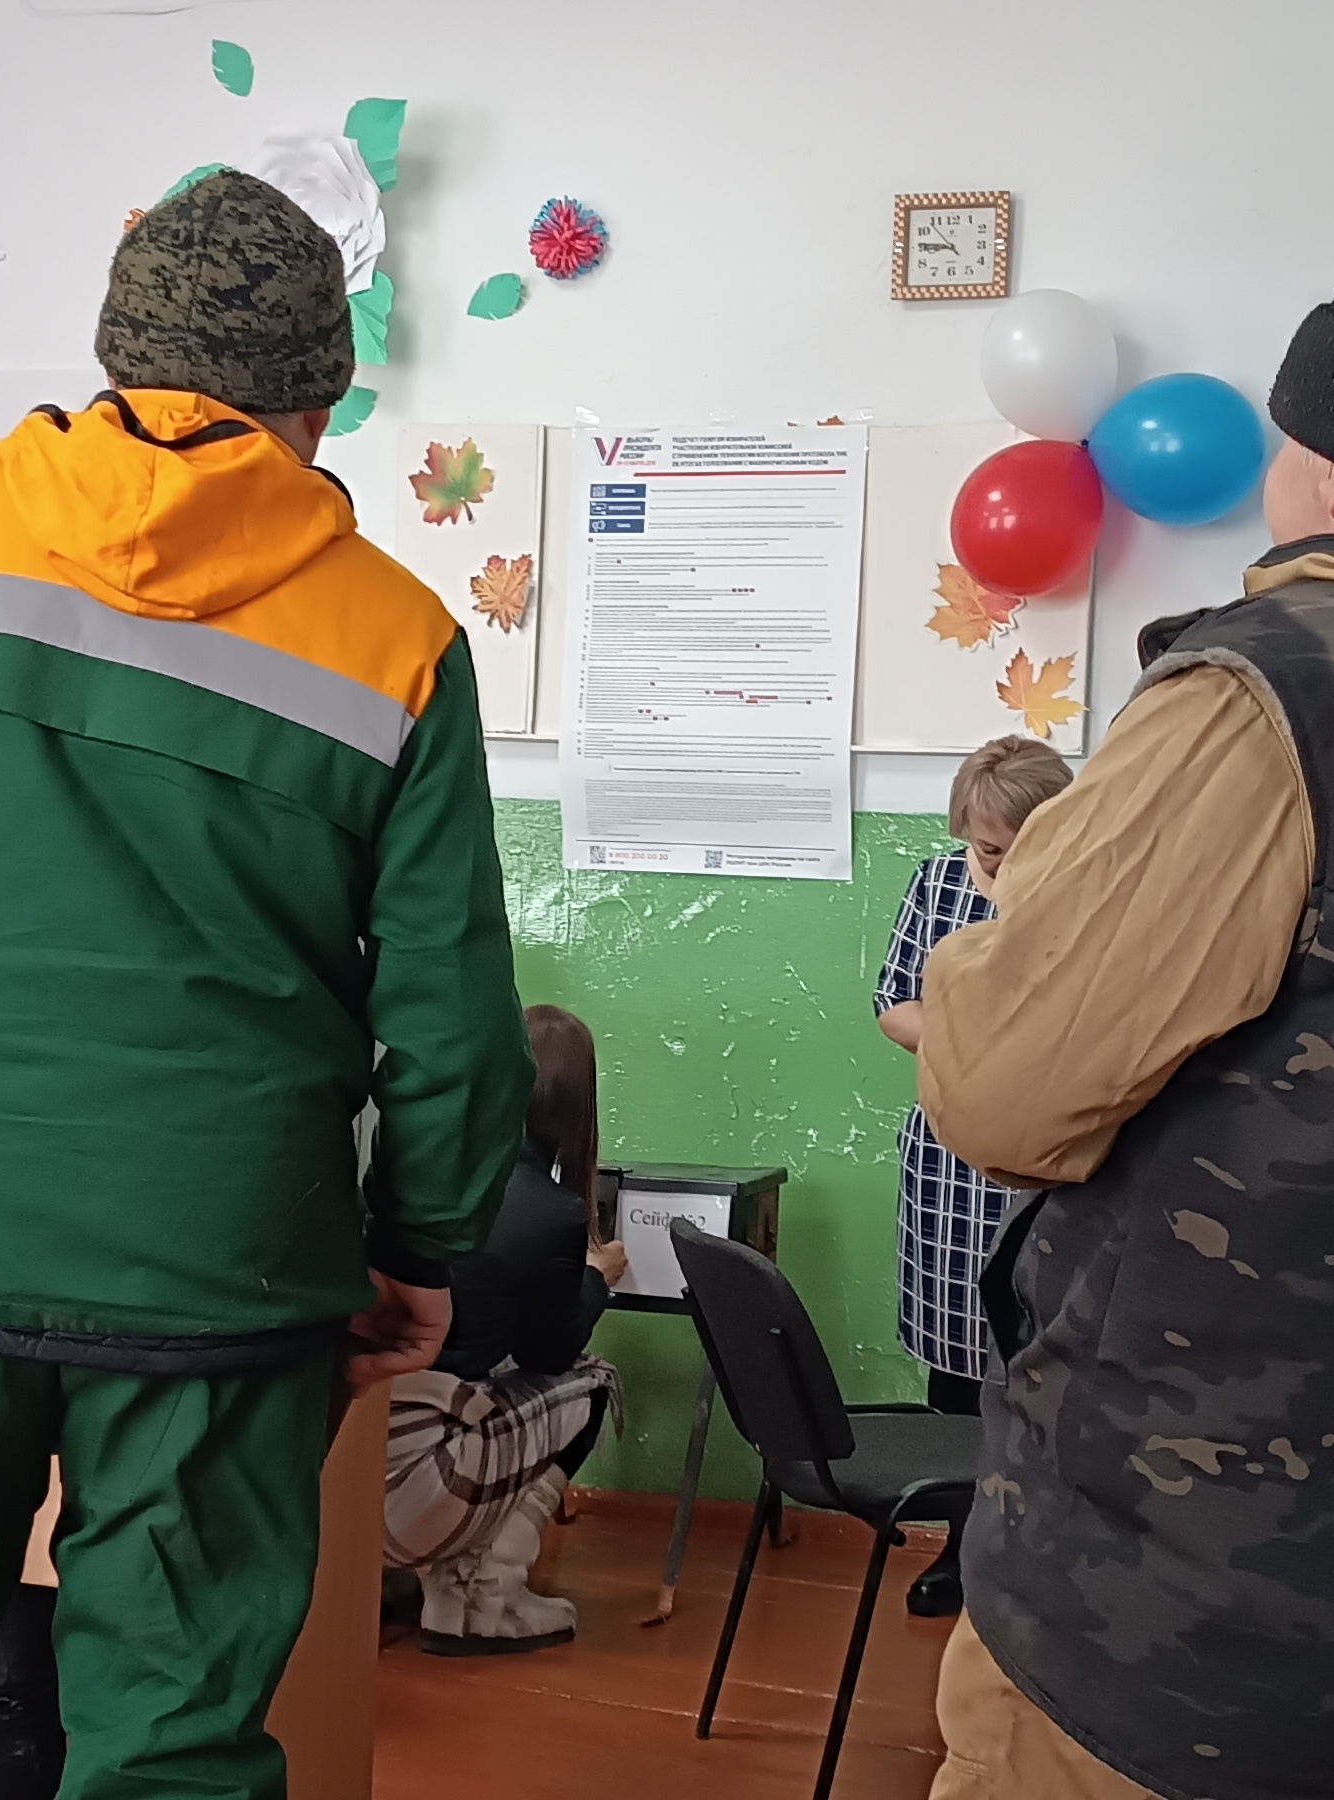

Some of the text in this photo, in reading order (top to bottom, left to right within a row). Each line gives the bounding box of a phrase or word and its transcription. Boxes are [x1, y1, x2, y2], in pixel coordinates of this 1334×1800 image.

[947, 215, 961, 226] 12
[968, 215, 973, 225] 1
[917, 224, 987, 236] 10 2
[976, 240, 987, 250] 3
[917, 256, 985, 269] 8 4
[930, 265, 974, 277] 7 6 5
